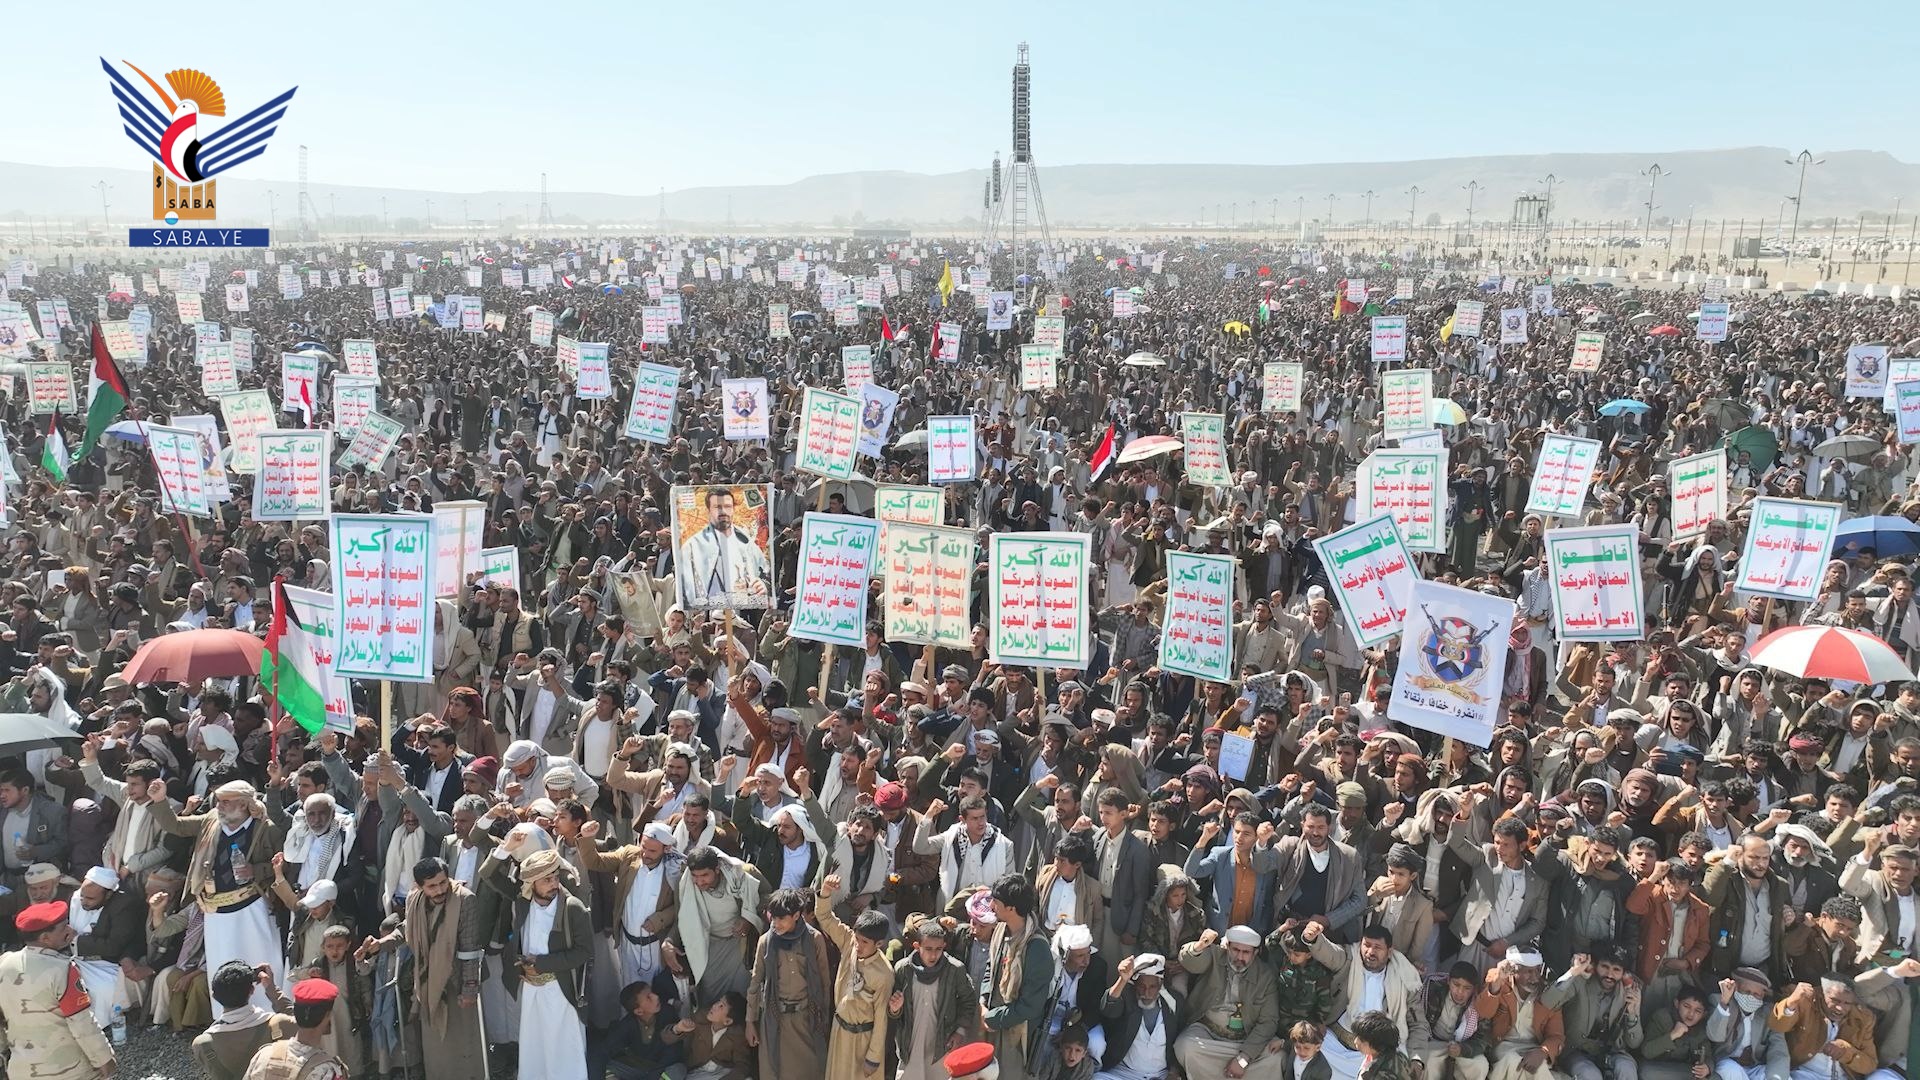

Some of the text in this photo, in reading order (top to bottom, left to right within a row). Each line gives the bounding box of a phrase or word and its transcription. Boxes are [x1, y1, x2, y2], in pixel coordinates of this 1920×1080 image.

[345, 525, 391, 558] أكبر
[395, 529, 423, 553] الله
[848, 532, 871, 550] الله
[842, 558, 866, 570] الموت
[1003, 544, 1078, 572] الله أكبر
[1558, 545, 1627, 568] قاطعوا
[389, 566, 423, 584] الموت
[839, 576, 864, 590] الموت
[1045, 577, 1077, 590] الموت
[1598, 572, 1630, 589] البضائع
[389, 590, 422, 610] الموت
[804, 592, 860, 608] اللعنة على اليهود
[1044, 597, 1077, 611] الموت
[1594, 593, 1599, 606] و
[346, 615, 373, 635] اليهود
[377, 617, 391, 636] على
[396, 617, 421, 634] اللعنة
[832, 611, 858, 631] النصر
[1002, 615, 1076, 630] اللعنة على اليهود
[1359, 607, 1406, 631] سرائيلية
[1042, 634, 1075, 654] النصر
[385, 641, 420, 668] النصر
